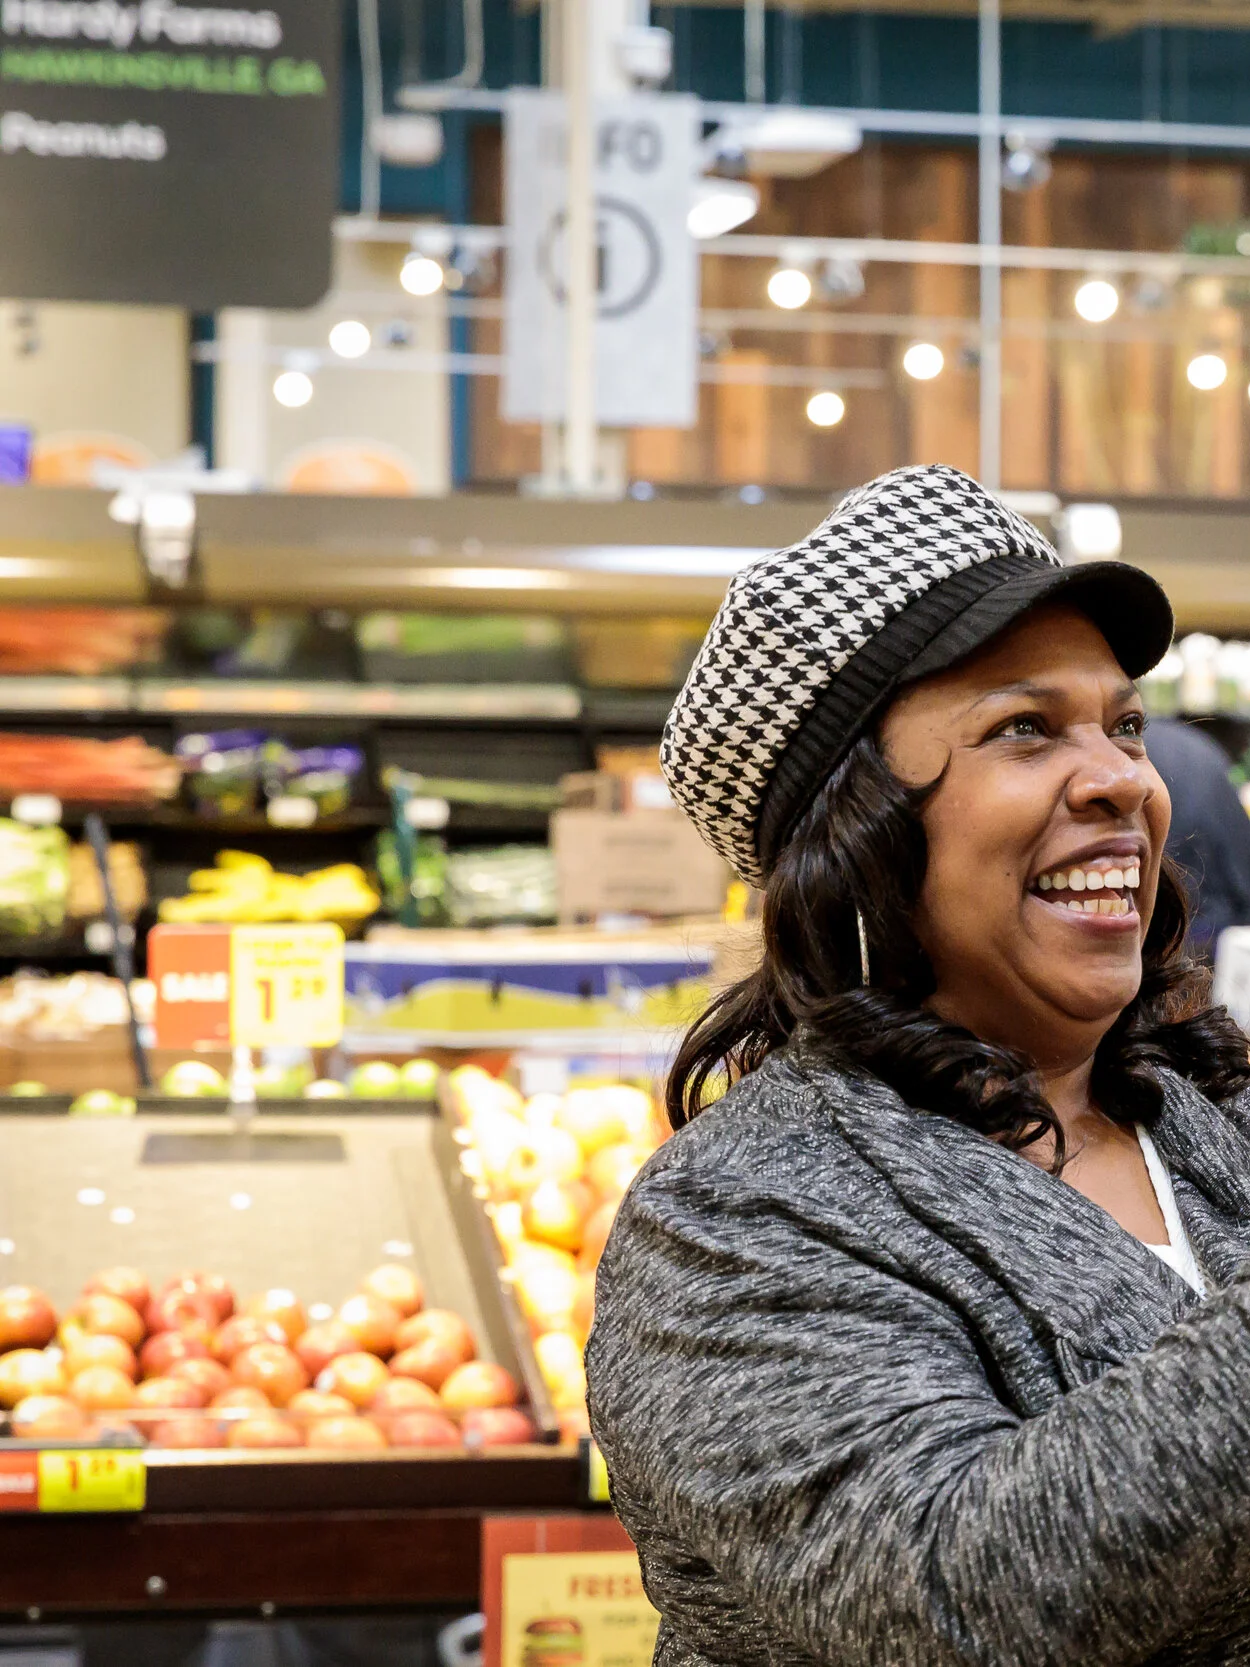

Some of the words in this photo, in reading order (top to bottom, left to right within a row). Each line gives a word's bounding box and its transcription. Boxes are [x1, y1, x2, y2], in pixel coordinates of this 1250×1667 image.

[0, 0, 136, 48] Hardy
[138, 0, 283, 49] Farms
[266, 56, 326, 96] GA
[0, 111, 167, 161] Peanuts
[161, 971, 229, 1003] SALE
